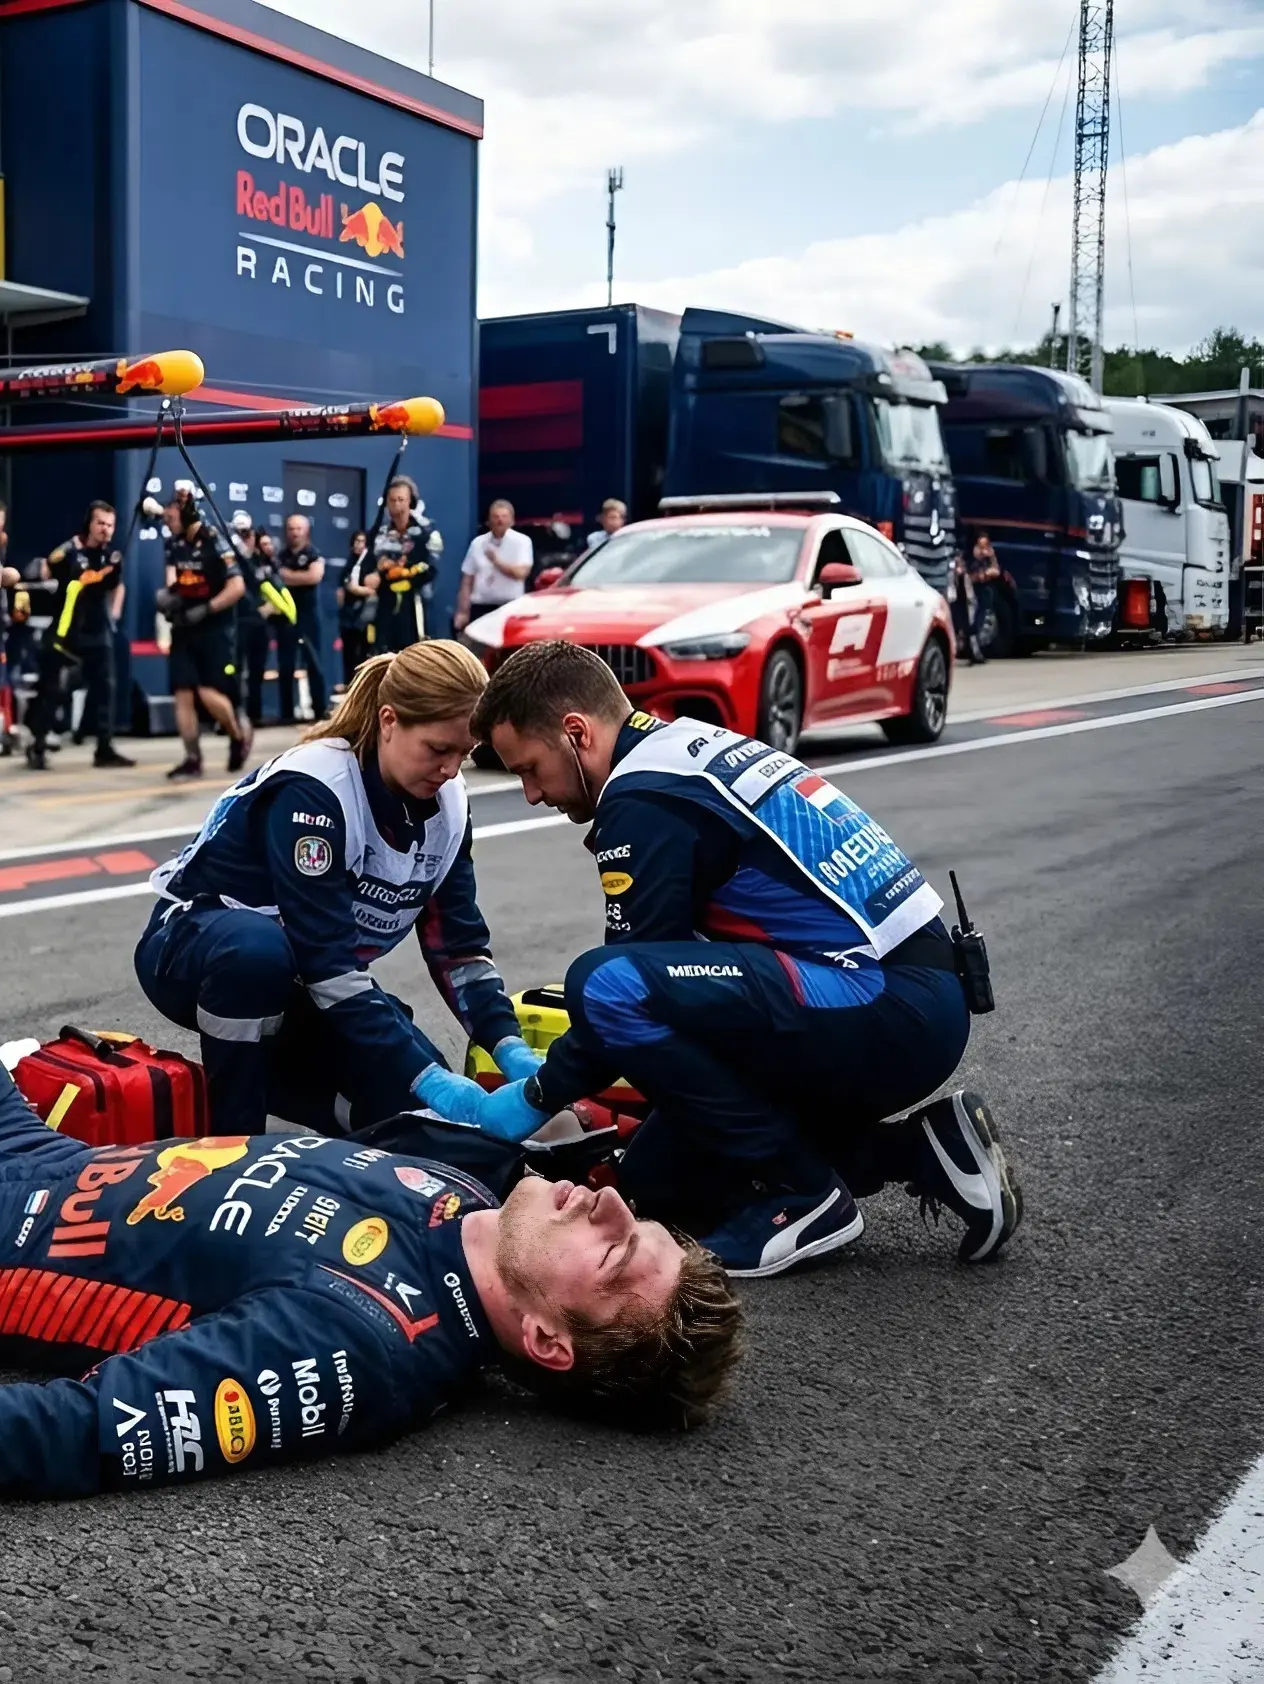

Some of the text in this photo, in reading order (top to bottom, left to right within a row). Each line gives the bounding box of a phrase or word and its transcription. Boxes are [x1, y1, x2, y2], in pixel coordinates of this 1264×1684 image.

[237, 102, 405, 203] ORACLE
[237, 169, 333, 239] Red Bull
[237, 246, 405, 314] RACING
[47, 1157, 145, 1259] Bull
